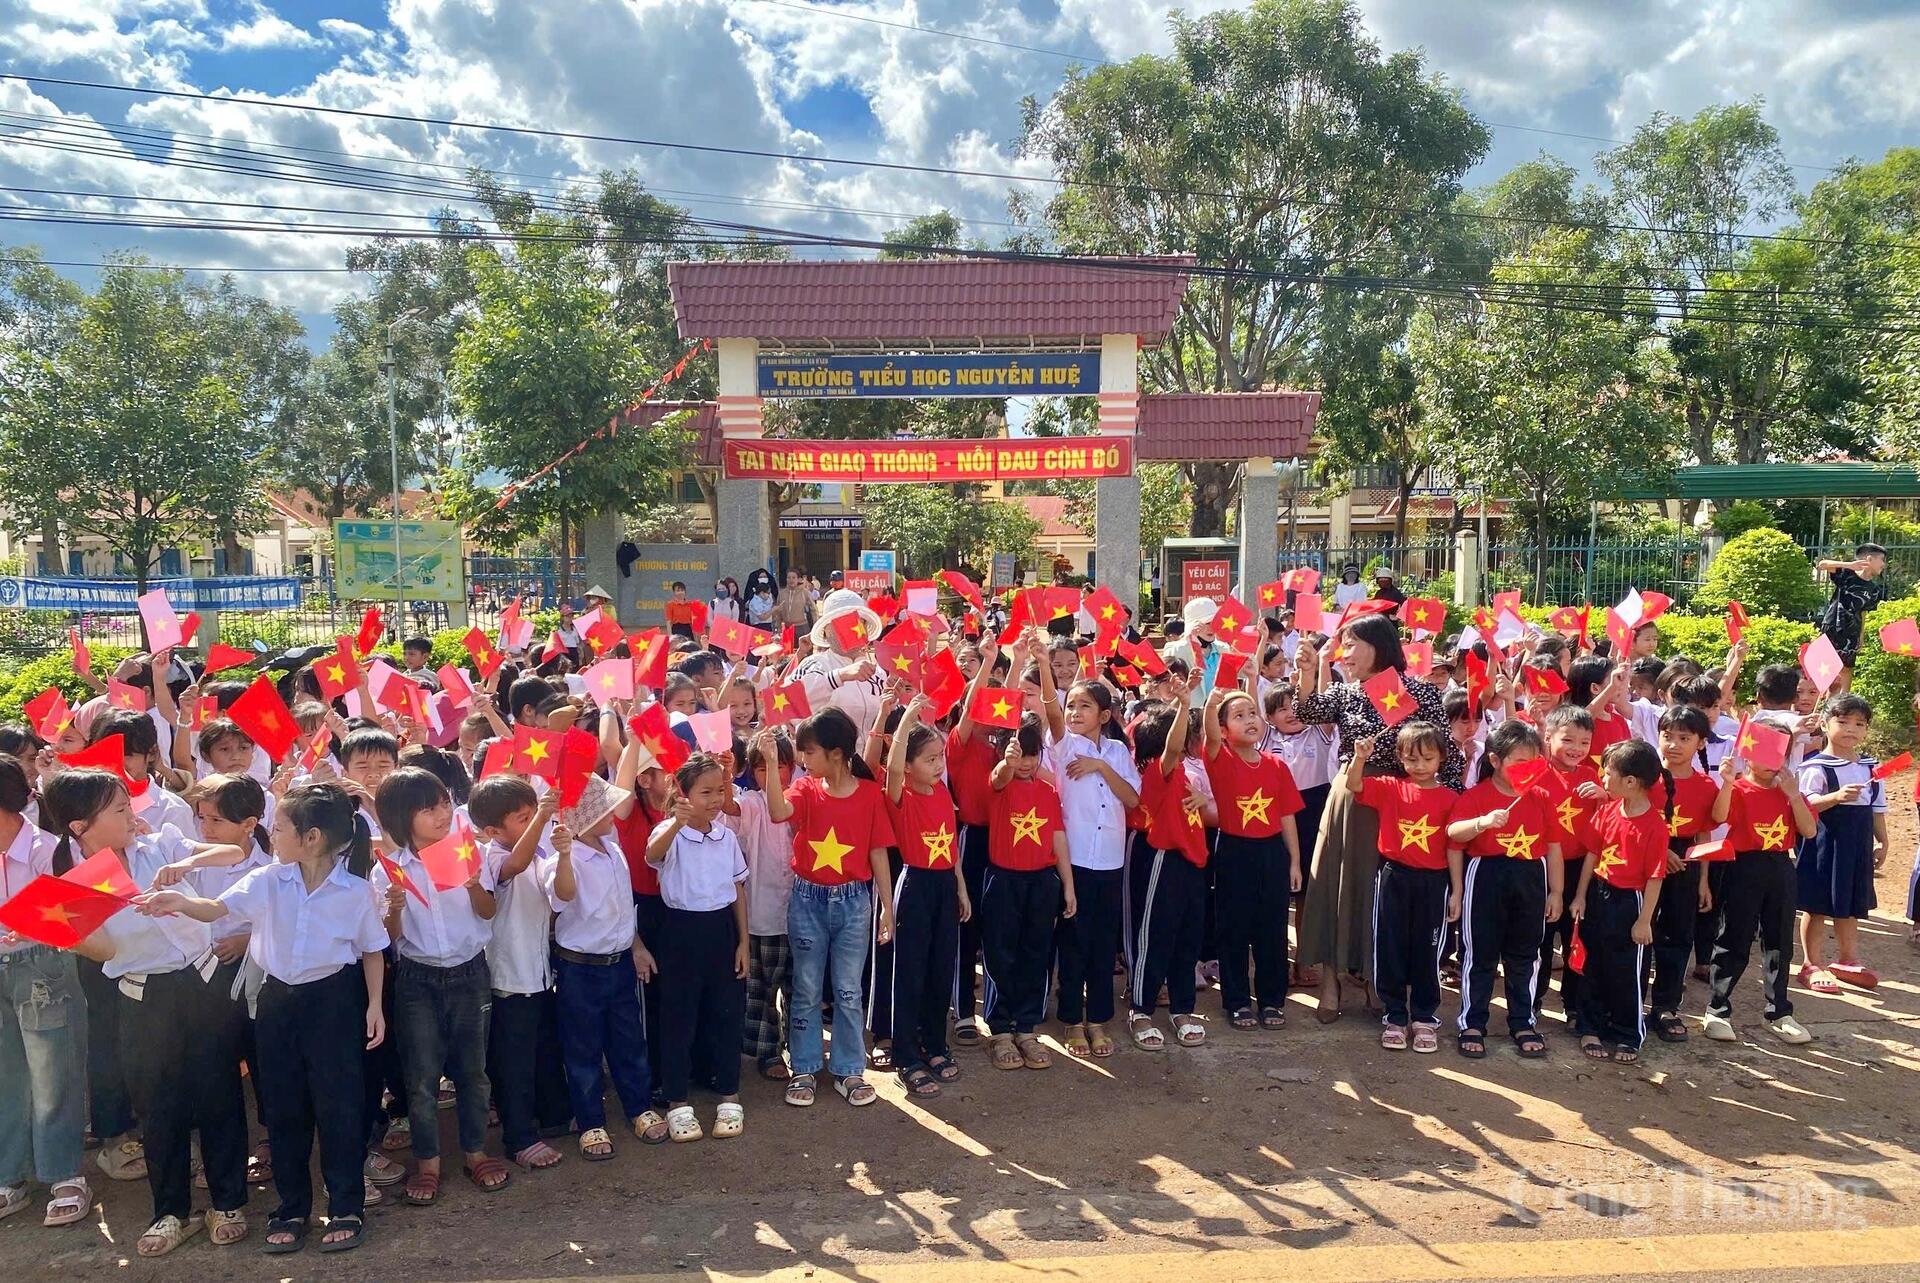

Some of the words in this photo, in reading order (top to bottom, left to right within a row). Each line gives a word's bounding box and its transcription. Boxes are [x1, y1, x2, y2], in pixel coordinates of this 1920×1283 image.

[773, 367, 854, 387] TRƯỜNG
[859, 362, 907, 386] TIỂU
[912, 369, 951, 390] HỌC
[956, 361, 1034, 385] NGUYỄN
[1040, 364, 1081, 388] HUỆ
[736, 450, 765, 470] TAI
[819, 453, 865, 473] GIAO
[871, 449, 937, 473] THÔNG
[957, 445, 992, 472] NỖI
[1043, 446, 1086, 470] CÒN
[1092, 445, 1120, 469] ĐÓ
[1188, 566, 1206, 578] YÊU
[1208, 565, 1225, 578] CẦU
[849, 577, 866, 588] YÊU
[869, 575, 886, 588] CẦU
[1192, 581, 1203, 591] BỎ
[1205, 581, 1222, 591] RÁC
